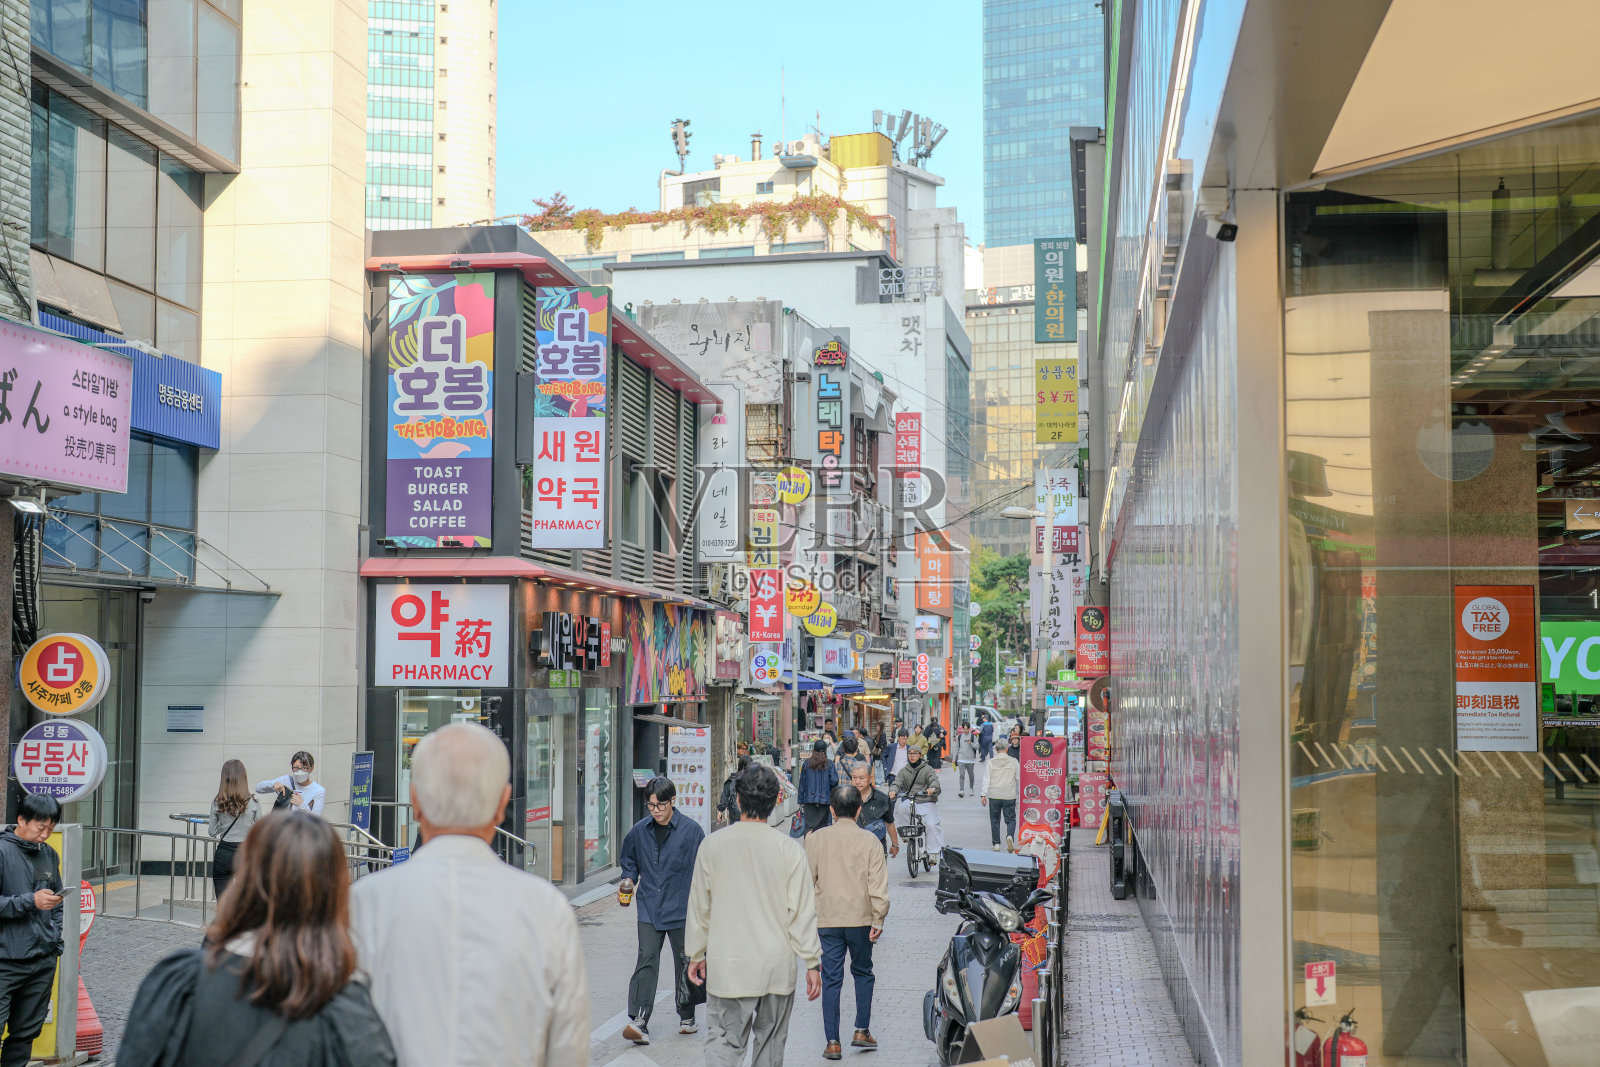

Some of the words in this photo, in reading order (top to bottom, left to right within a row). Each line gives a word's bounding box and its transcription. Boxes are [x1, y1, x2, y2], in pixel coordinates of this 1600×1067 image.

[880, 267, 942, 280] COFFEE
[1044, 250, 1065, 283] 의원
[880, 282, 912, 295] MILK
[914, 282, 940, 294] TEA
[1008, 284, 1035, 302] 교원
[1044, 289, 1067, 338] 한의원
[557, 311, 587, 343] 더
[422, 319, 462, 364] 더
[540, 343, 602, 377] 호봉
[71, 368, 119, 399] 스타일가방
[1038, 365, 1076, 380] 상품권
[158, 383, 203, 414] 명동금융센터
[398, 365, 484, 411] 호봉
[1062, 390, 1076, 403] 元
[63, 404, 70, 417] a
[73, 403, 98, 426] style
[100, 408, 118, 434] bag
[897, 419, 919, 432] 순대
[816, 373, 845, 489] 노래타운
[897, 435, 919, 449] 수육
[1051, 431, 1063, 440] 2F
[64, 434, 116, 466] 投売り専門
[537, 430, 601, 464] 새원
[896, 449, 919, 463] 국밥
[413, 466, 463, 479] TOAST
[407, 482, 469, 495] BURGER
[536, 477, 600, 510] 약국
[413, 500, 463, 512] SALAD
[408, 516, 467, 529] COFFEE
[534, 519, 602, 530] PHARMACY
[757, 573, 776, 602] $
[928, 558, 943, 606] 마라탕
[390, 590, 450, 658] 약
[755, 604, 777, 628] ¥
[1470, 611, 1502, 623] TAX
[1472, 623, 1502, 633] FREE
[547, 611, 599, 672] 새원약국
[751, 631, 781, 639] FX-Korea
[391, 664, 493, 681] PHARMACY
[27, 680, 72, 707] 사주까페
[73, 679, 93, 699] 3층
[1456, 694, 1520, 710] 即刻退税
[43, 725, 69, 739] 명동
[21, 742, 89, 777] 부동산
[603, 692, 611, 854] PHARMACY
